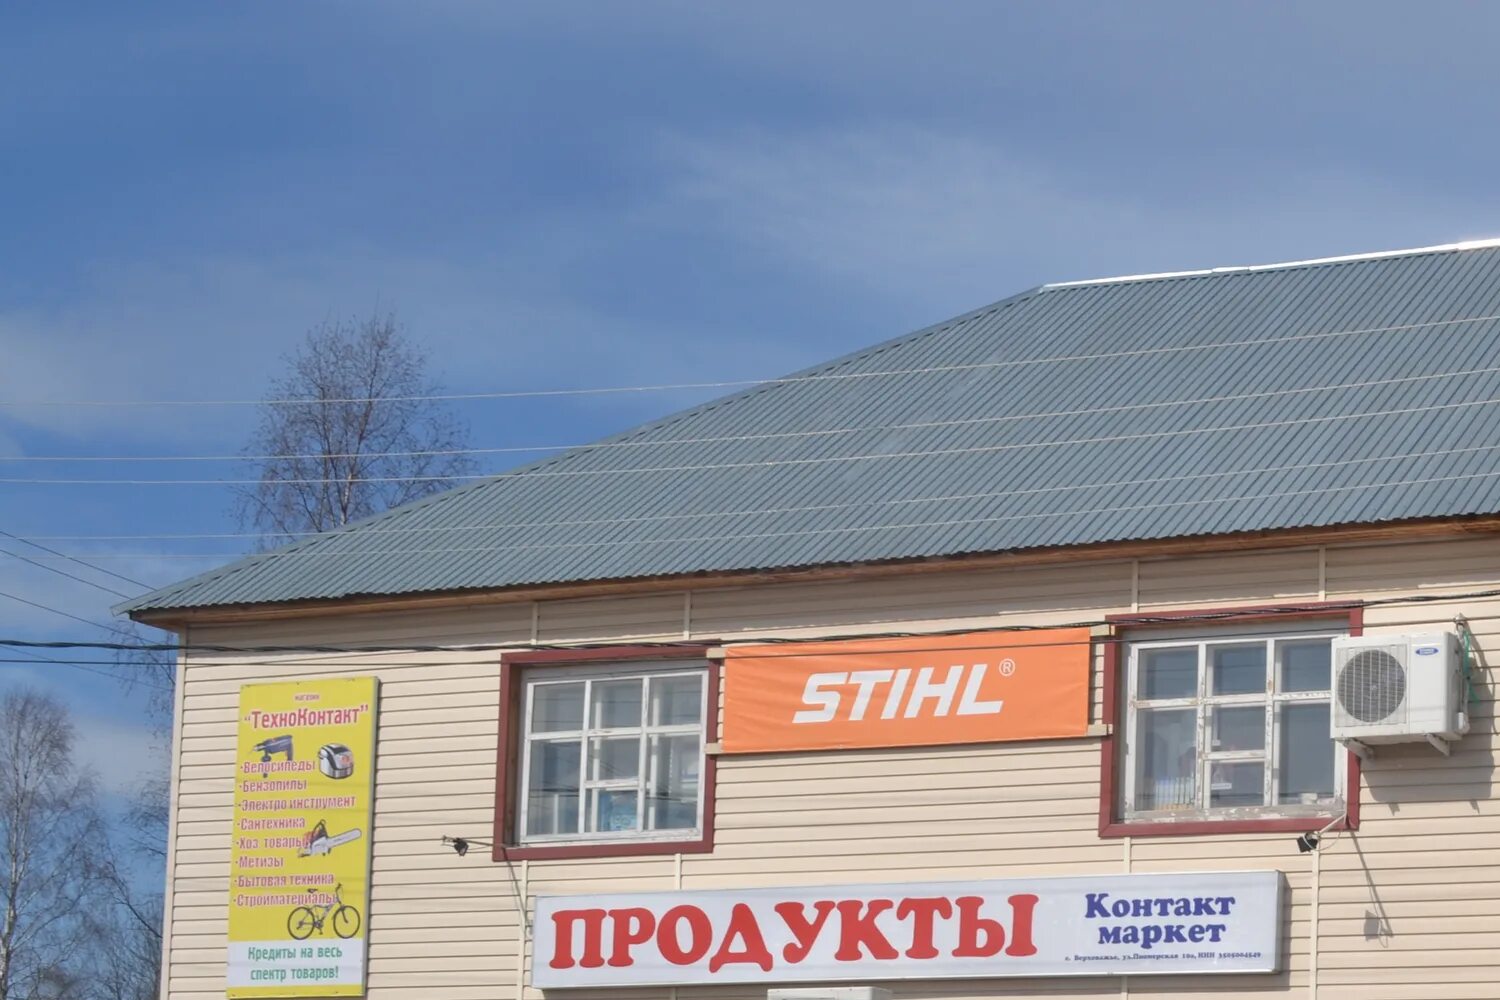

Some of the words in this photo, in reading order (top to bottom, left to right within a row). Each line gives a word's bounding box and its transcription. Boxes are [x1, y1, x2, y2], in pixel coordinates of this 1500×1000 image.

[243, 761, 316, 774] Велосипеды
[242, 779, 307, 793] Бензопилы
[240, 817, 306, 831] Сантехника
[239, 856, 284, 868] Метизы
[237, 875, 287, 888] Бытовая
[289, 874, 334, 885] техника
[1085, 893, 1236, 918] Контакт
[549, 894, 1039, 973] ПРОДУКТЫ
[1097, 923, 1227, 950] маркет
[248, 947, 297, 960] Кредиты
[300, 947, 313, 958] на
[317, 946, 343, 958] весь
[250, 968, 287, 982] спектр
[291, 966, 339, 981] товаров!
